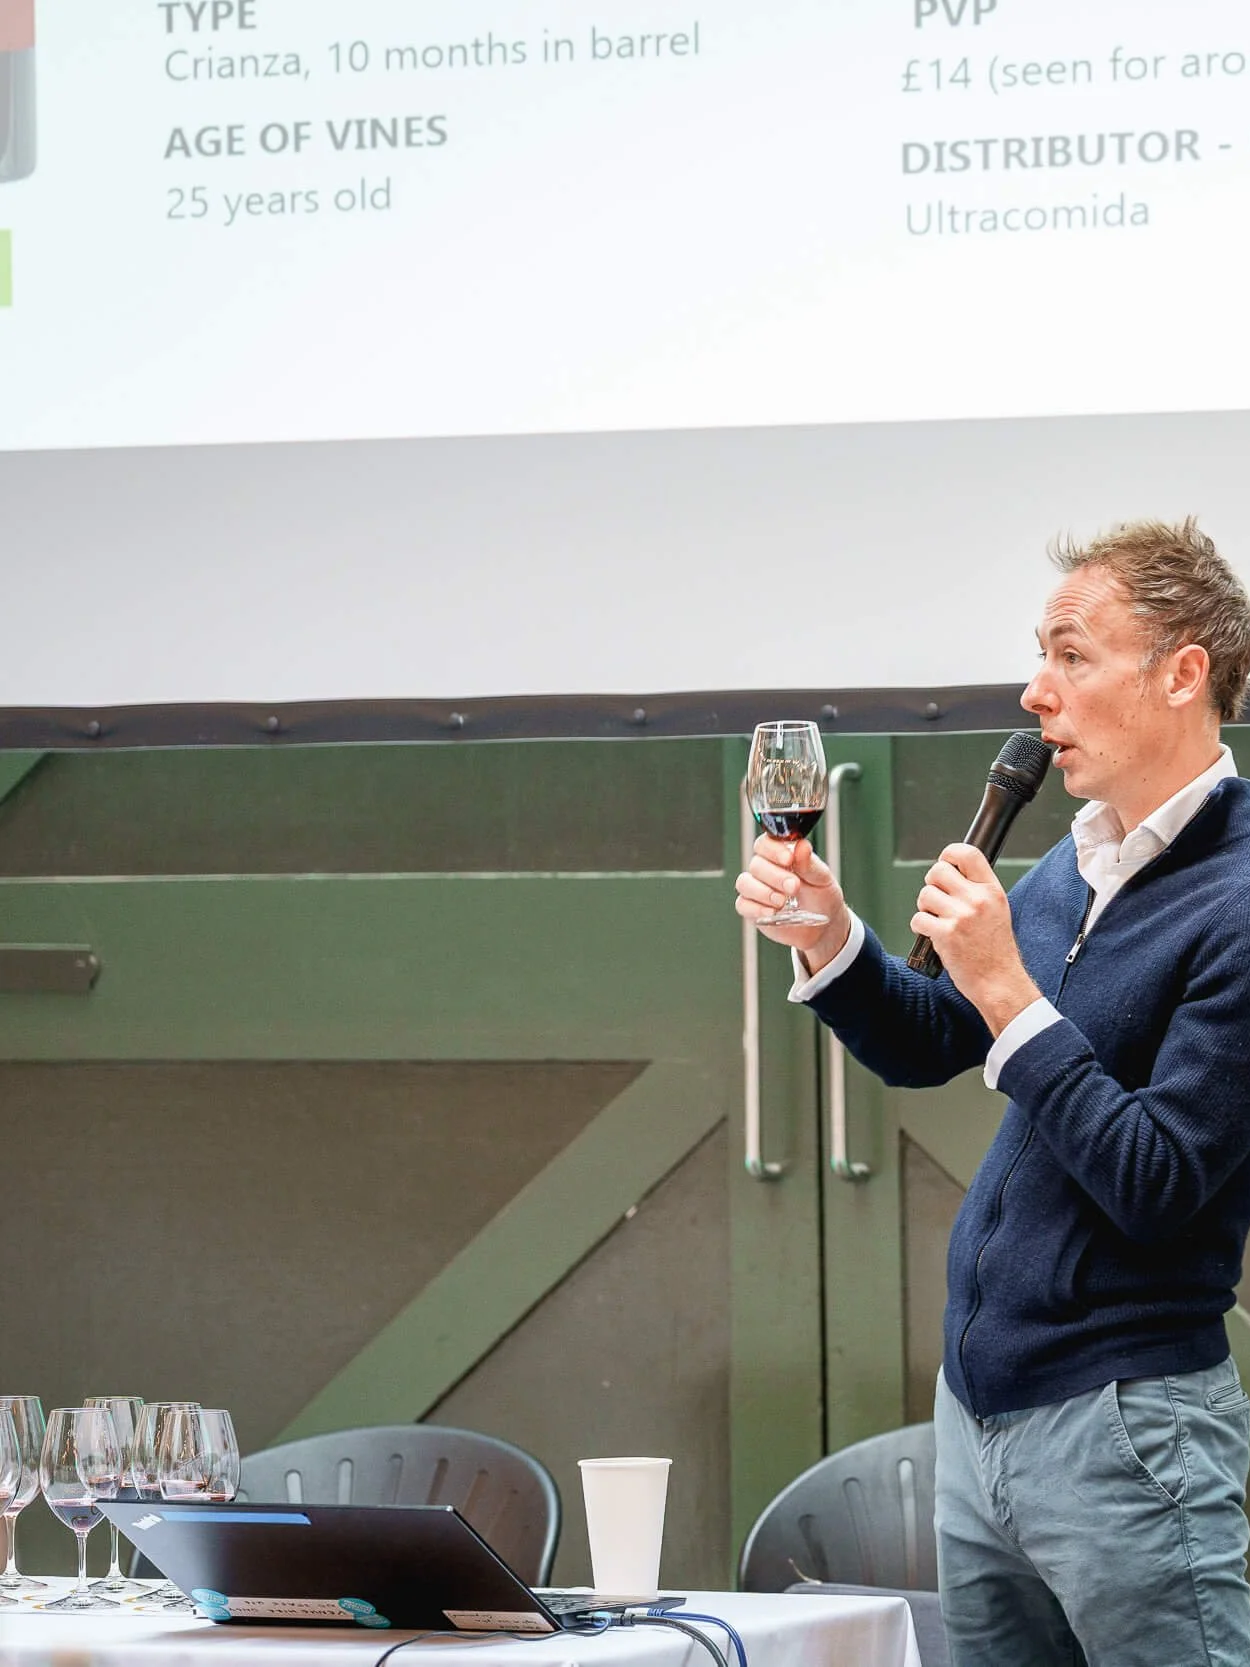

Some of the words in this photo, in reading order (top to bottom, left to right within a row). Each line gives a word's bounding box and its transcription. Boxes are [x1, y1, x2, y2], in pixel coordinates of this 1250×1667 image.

[157, 0, 256, 33] TYPE
[915, 0, 997, 28] PVP
[165, 46, 309, 81] Crianza,
[329, 40, 369, 73] 10
[386, 32, 526, 70] months
[544, 29, 574, 62] in
[592, 21, 699, 59] barrel
[902, 57, 971, 92] £14
[989, 56, 1091, 94] (seen
[1109, 46, 1166, 81] for
[164, 125, 245, 159] AGE
[260, 121, 311, 153] OF
[326, 115, 447, 150] VINES
[902, 130, 1200, 174] DISTRIBUTOR
[167, 186, 208, 219] 25
[223, 190, 319, 226] years
[334, 177, 390, 211] old
[907, 192, 1148, 235] Ultracomida
